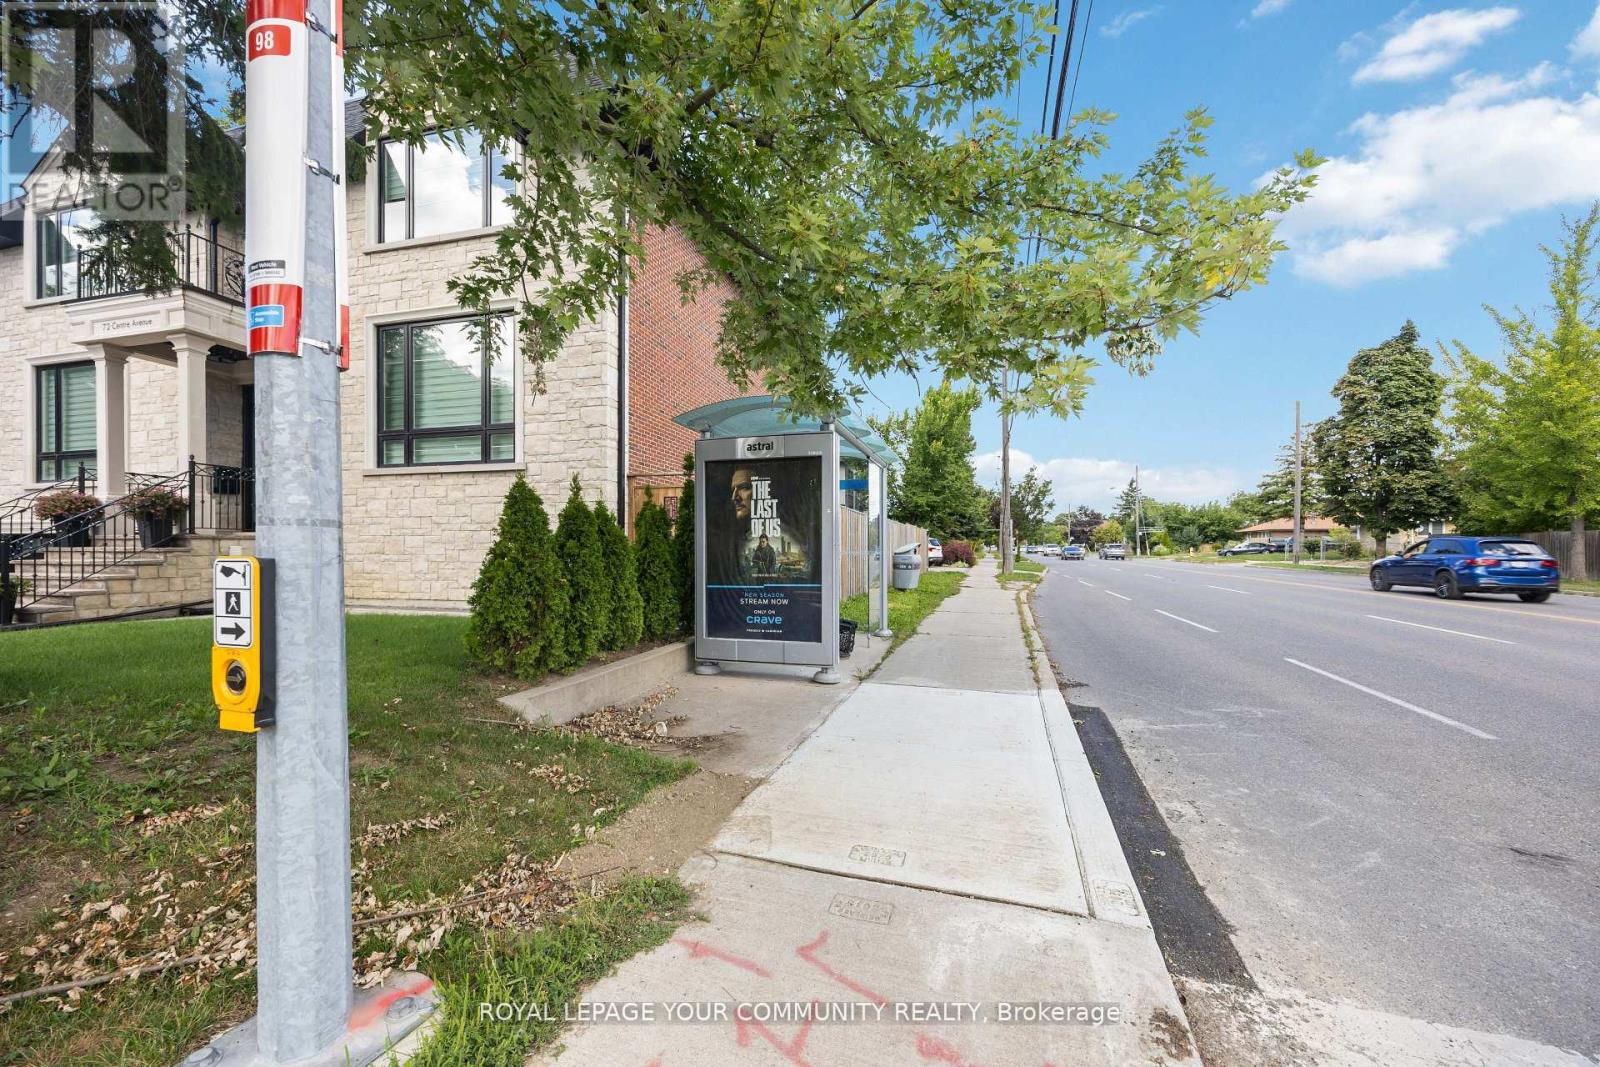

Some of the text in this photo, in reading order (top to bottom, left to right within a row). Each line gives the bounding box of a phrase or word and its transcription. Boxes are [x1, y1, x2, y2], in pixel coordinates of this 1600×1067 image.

[256, 30, 274, 51] 98
[132, 319, 153, 327] Avenue
[746, 441, 774, 452] astral
[751, 480, 771, 500] THE
[750, 499, 779, 519] LAST
[751, 518, 781, 538] OF US
